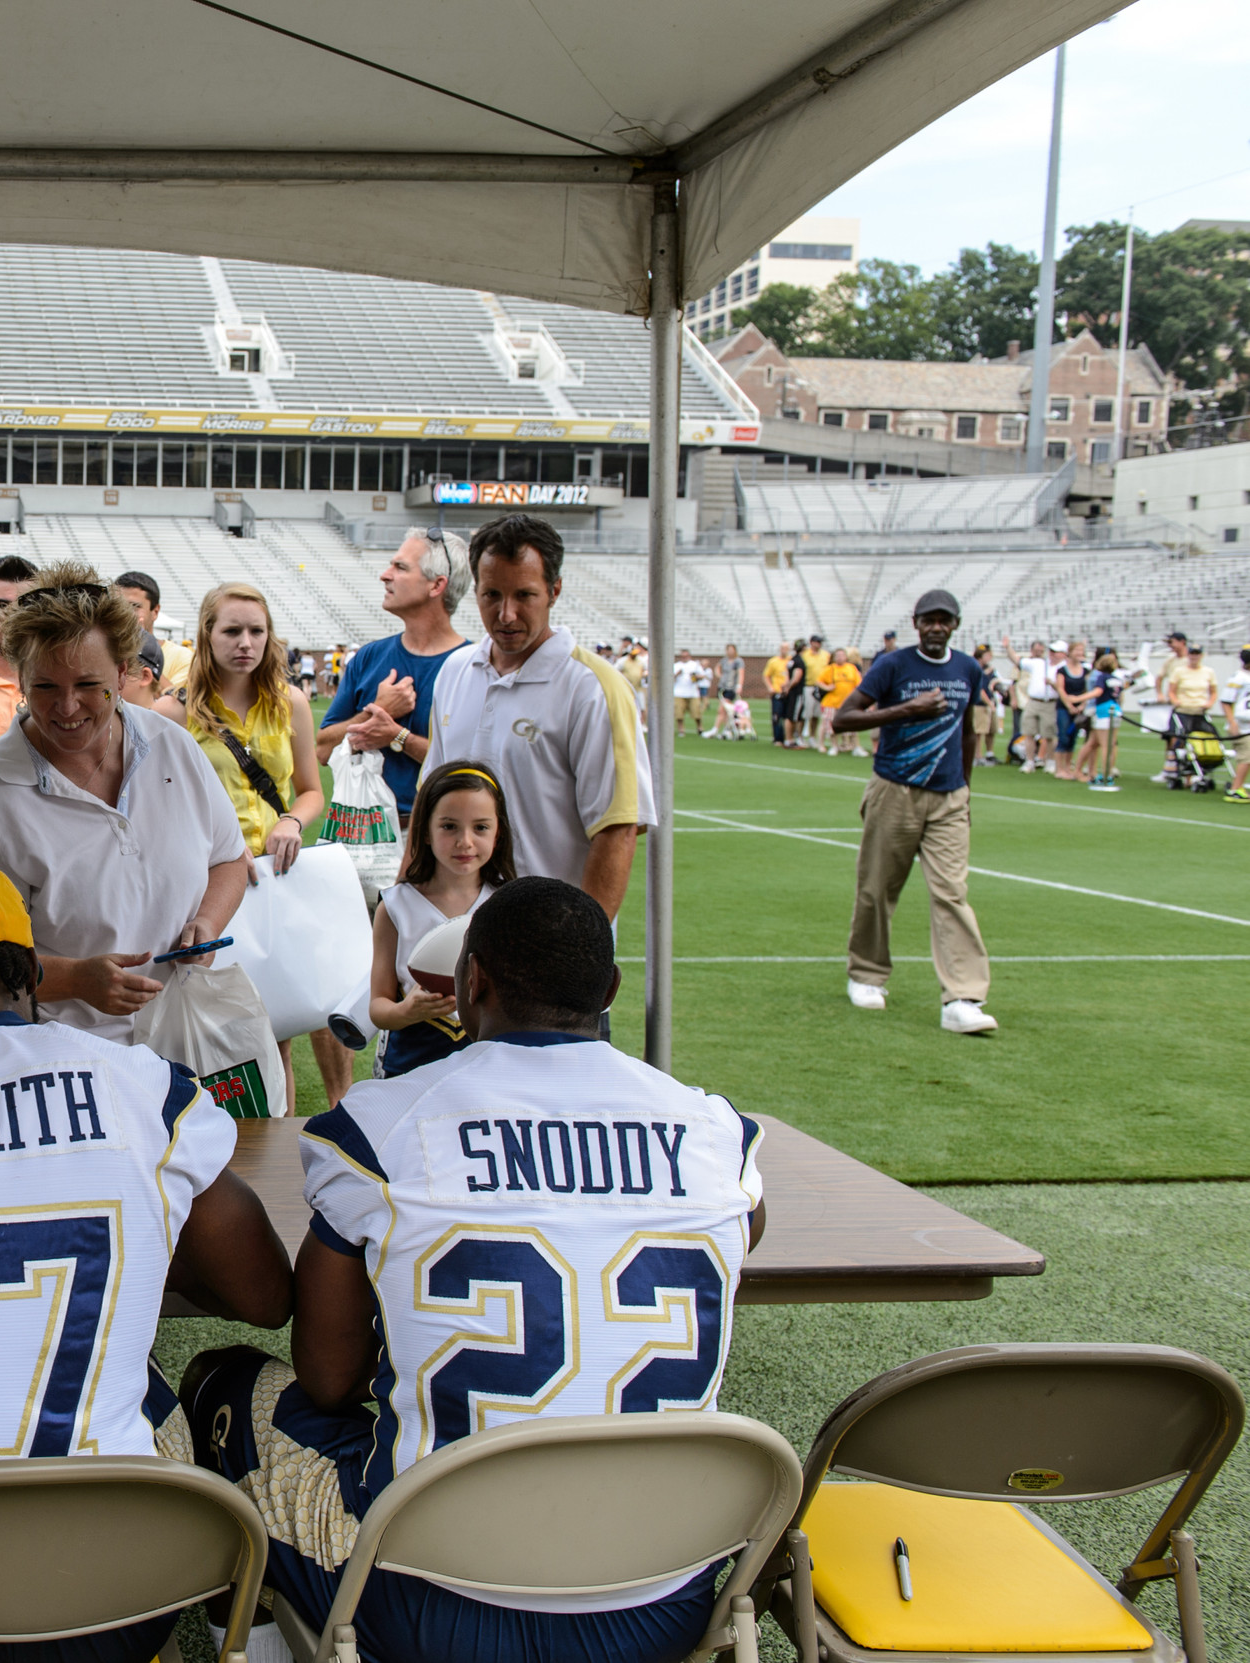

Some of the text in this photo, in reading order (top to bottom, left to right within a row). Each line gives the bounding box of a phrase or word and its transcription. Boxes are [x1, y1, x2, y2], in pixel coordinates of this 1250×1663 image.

[106, 417, 155, 428] DODD
[201, 419, 265, 431] MORRIS
[309, 422, 376, 434] GASTON
[422, 424, 468, 435] BECK
[515, 427, 567, 438] RHINO
[479, 484, 529, 504] FAN
[529, 485, 557, 504] DAY
[556, 485, 589, 504] 2012
[458, 1119, 687, 1197] SNODDY
[414, 1223, 731, 1458] 22
